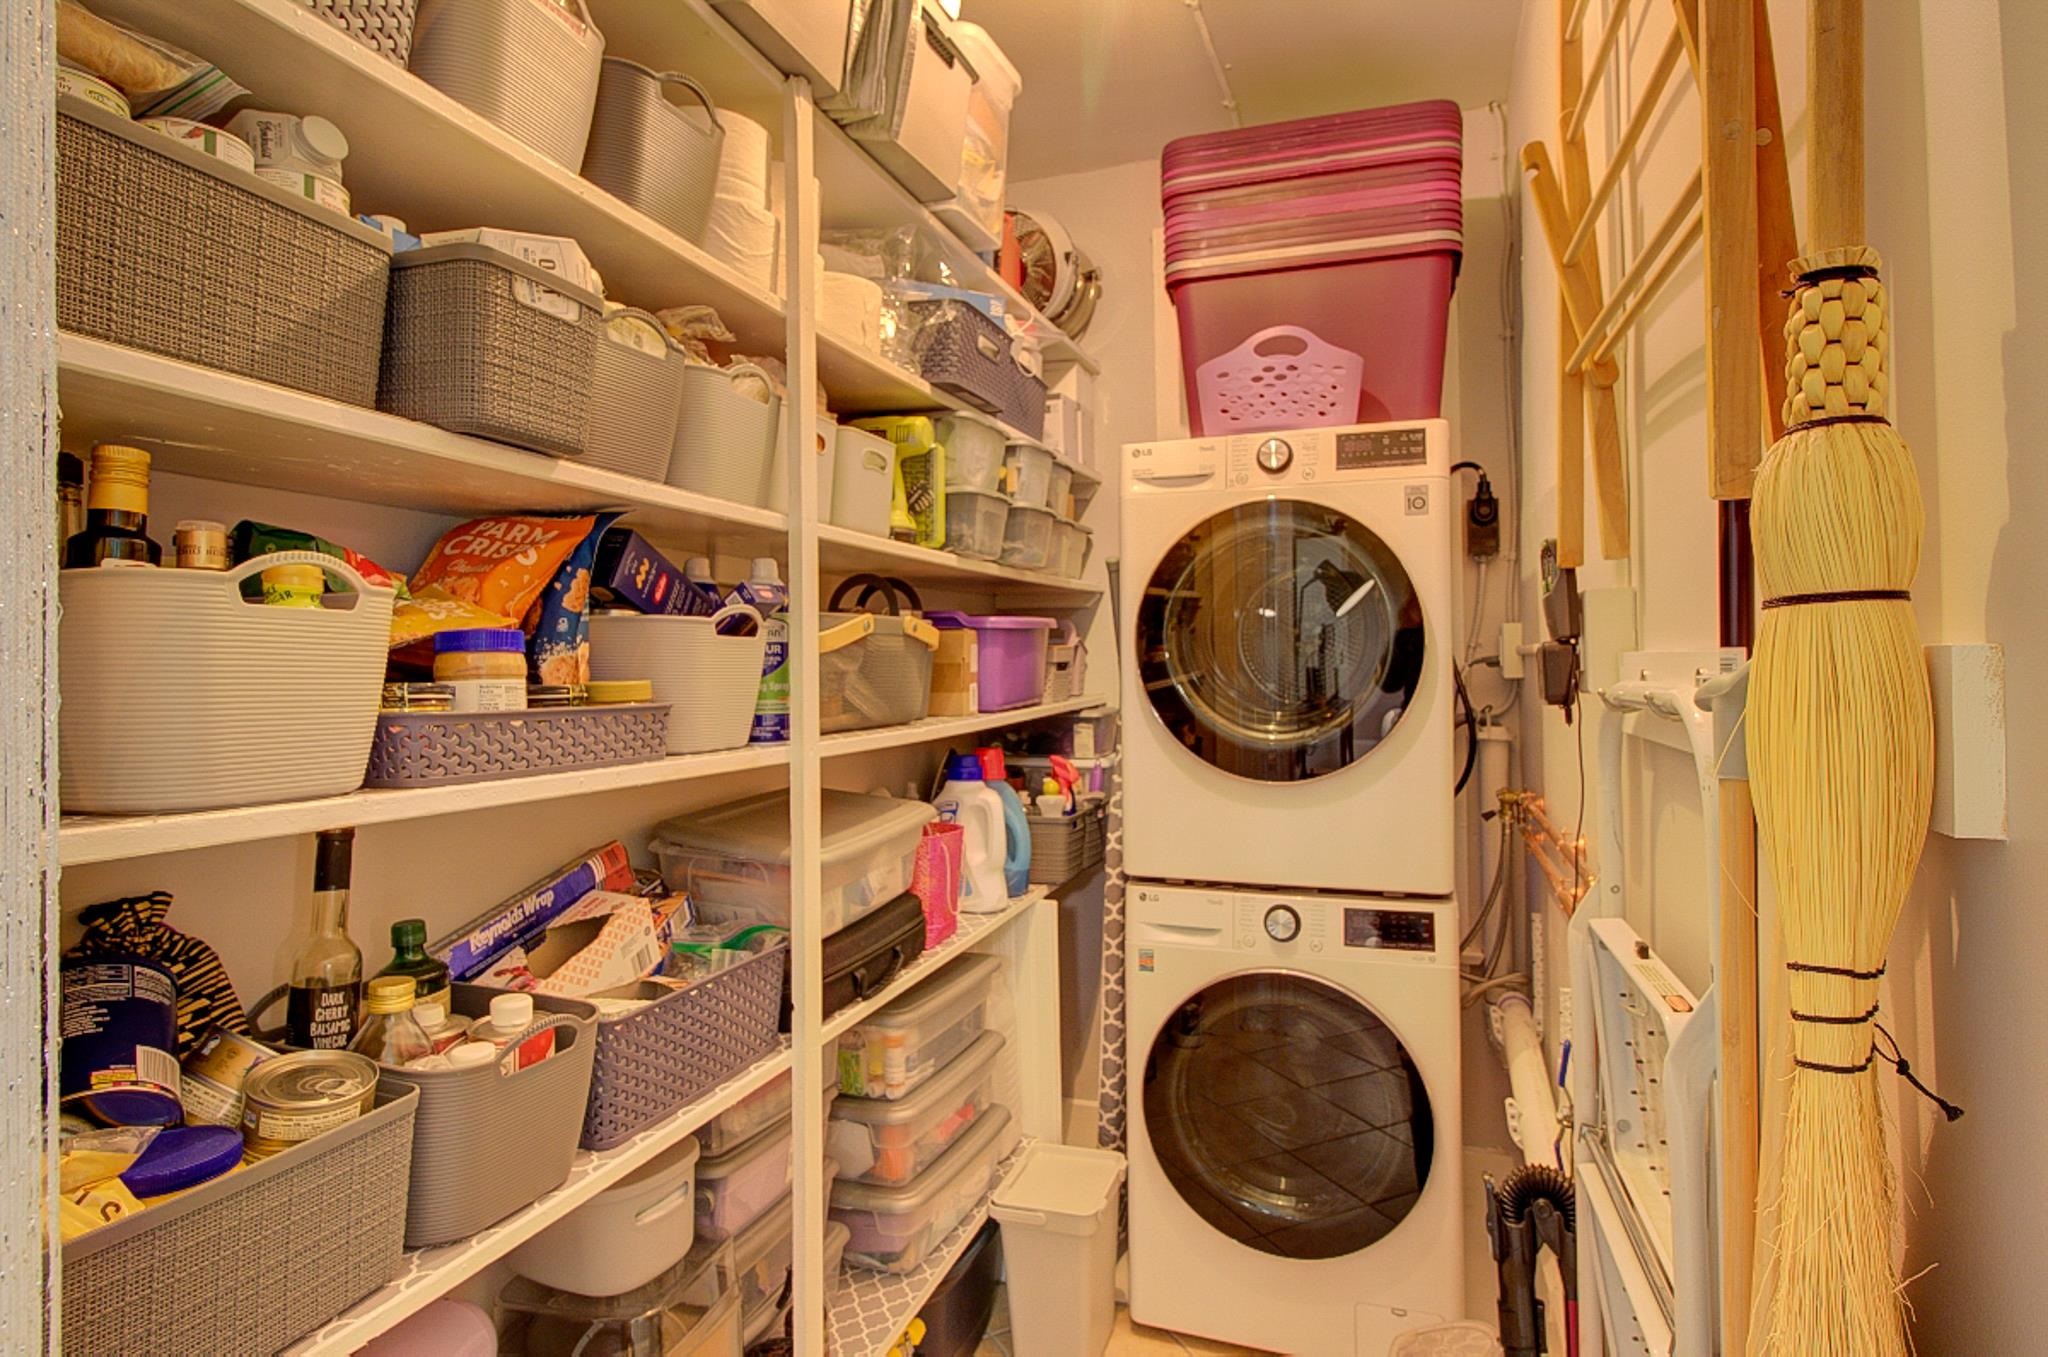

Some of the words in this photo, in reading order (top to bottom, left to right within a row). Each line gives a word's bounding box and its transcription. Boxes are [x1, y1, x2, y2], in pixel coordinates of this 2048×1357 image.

[470, 520, 560, 544] PARM
[469, 905, 526, 954] Reynolds
[521, 889, 555, 918] Wrap
[321, 991, 346, 1008] DARK
